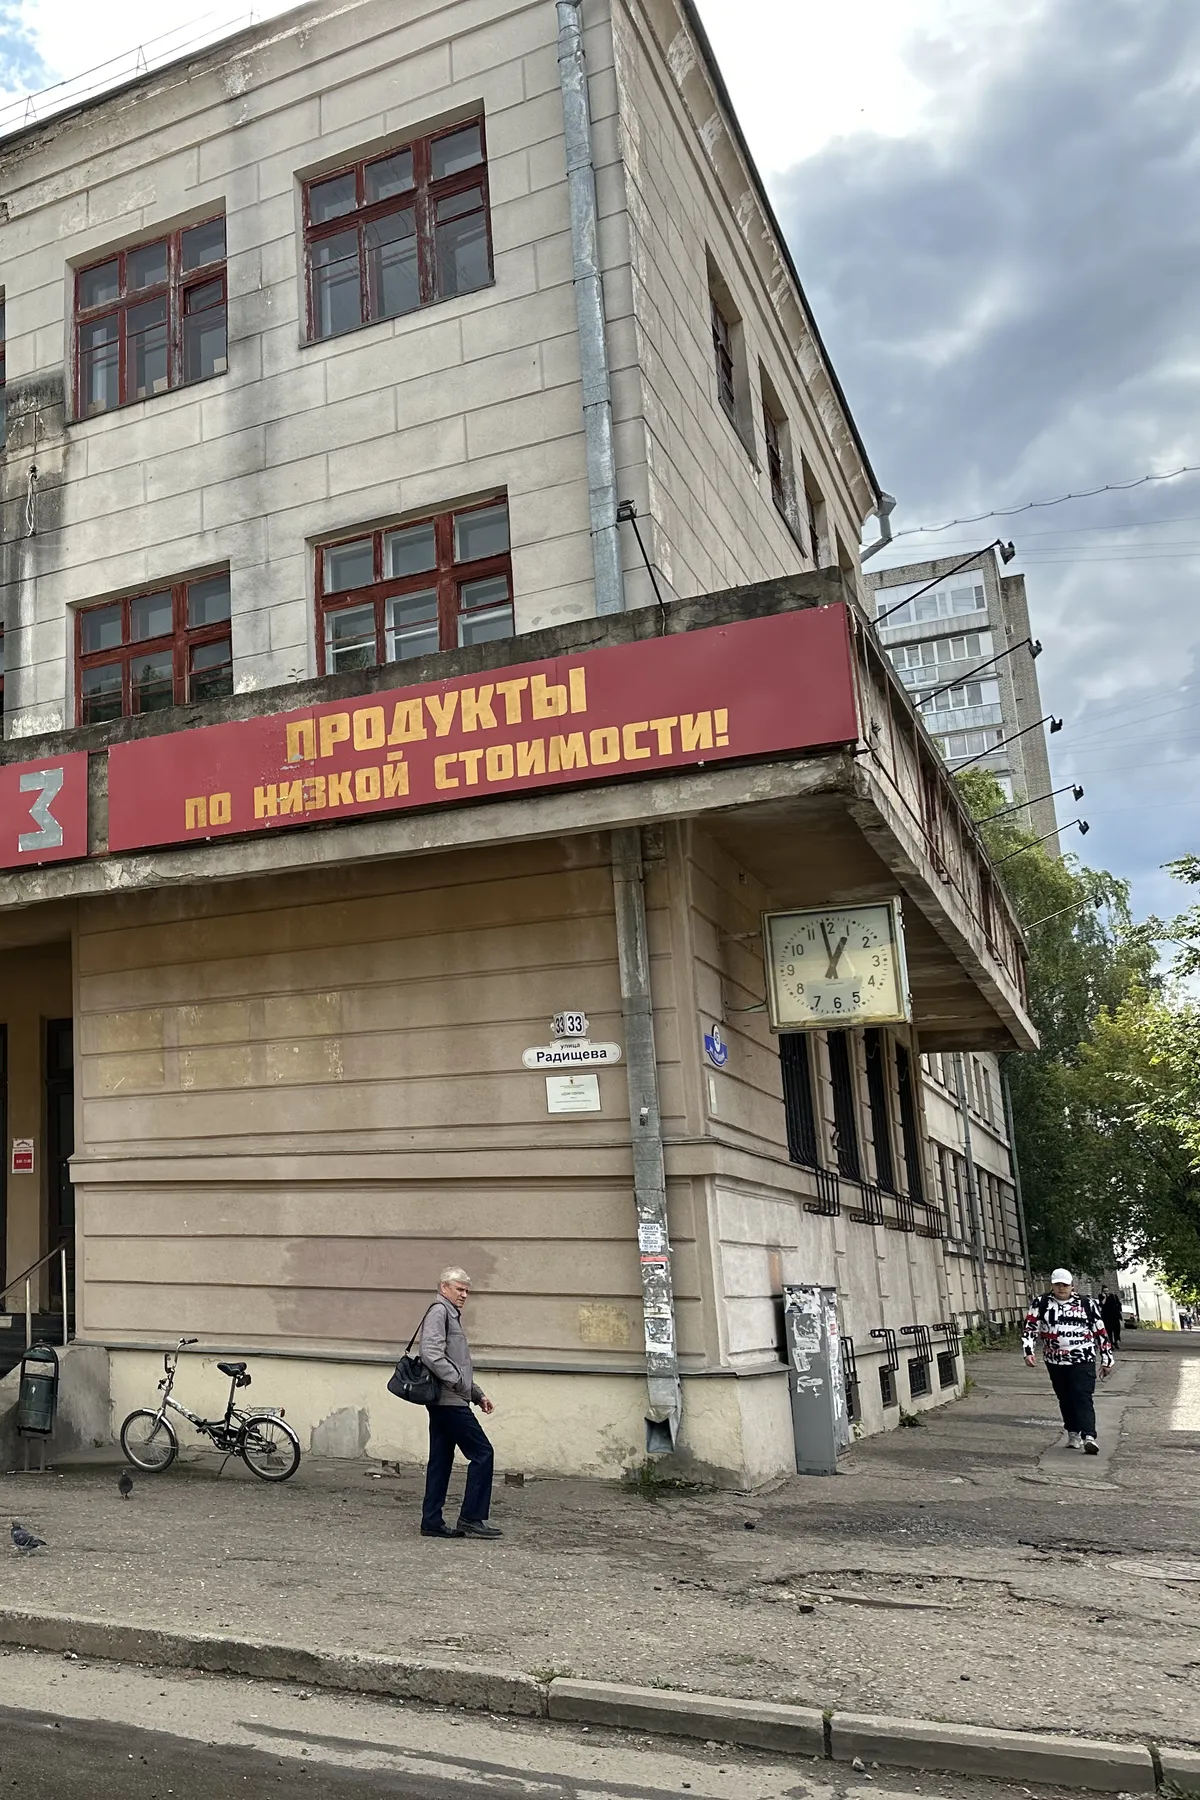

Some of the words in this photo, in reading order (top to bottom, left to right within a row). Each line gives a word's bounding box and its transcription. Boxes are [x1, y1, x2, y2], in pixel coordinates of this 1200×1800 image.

[285, 666, 588, 762] ПРОДУКТЫ
[184, 791, 232, 831] ПО
[253, 751, 411, 819] НИЗКОЙ
[434, 708, 729, 789] СТОИМОСТИ!
[807, 928, 815, 941] 11
[846, 925, 850, 936] 1
[862, 936, 870, 948] 2
[792, 944, 804, 956] 10
[872, 955, 880, 967] 3
[787, 964, 795, 976] 9
[867, 975, 875, 987] 4
[796, 983, 804, 994] 8
[813, 996, 821, 1007] 7
[833, 997, 842, 1009] 6
[852, 992, 860, 1003] 5
[555, 1016, 564, 1034] 33
[568, 1015, 582, 1032] 33
[536, 1049, 607, 1063] Радищева
